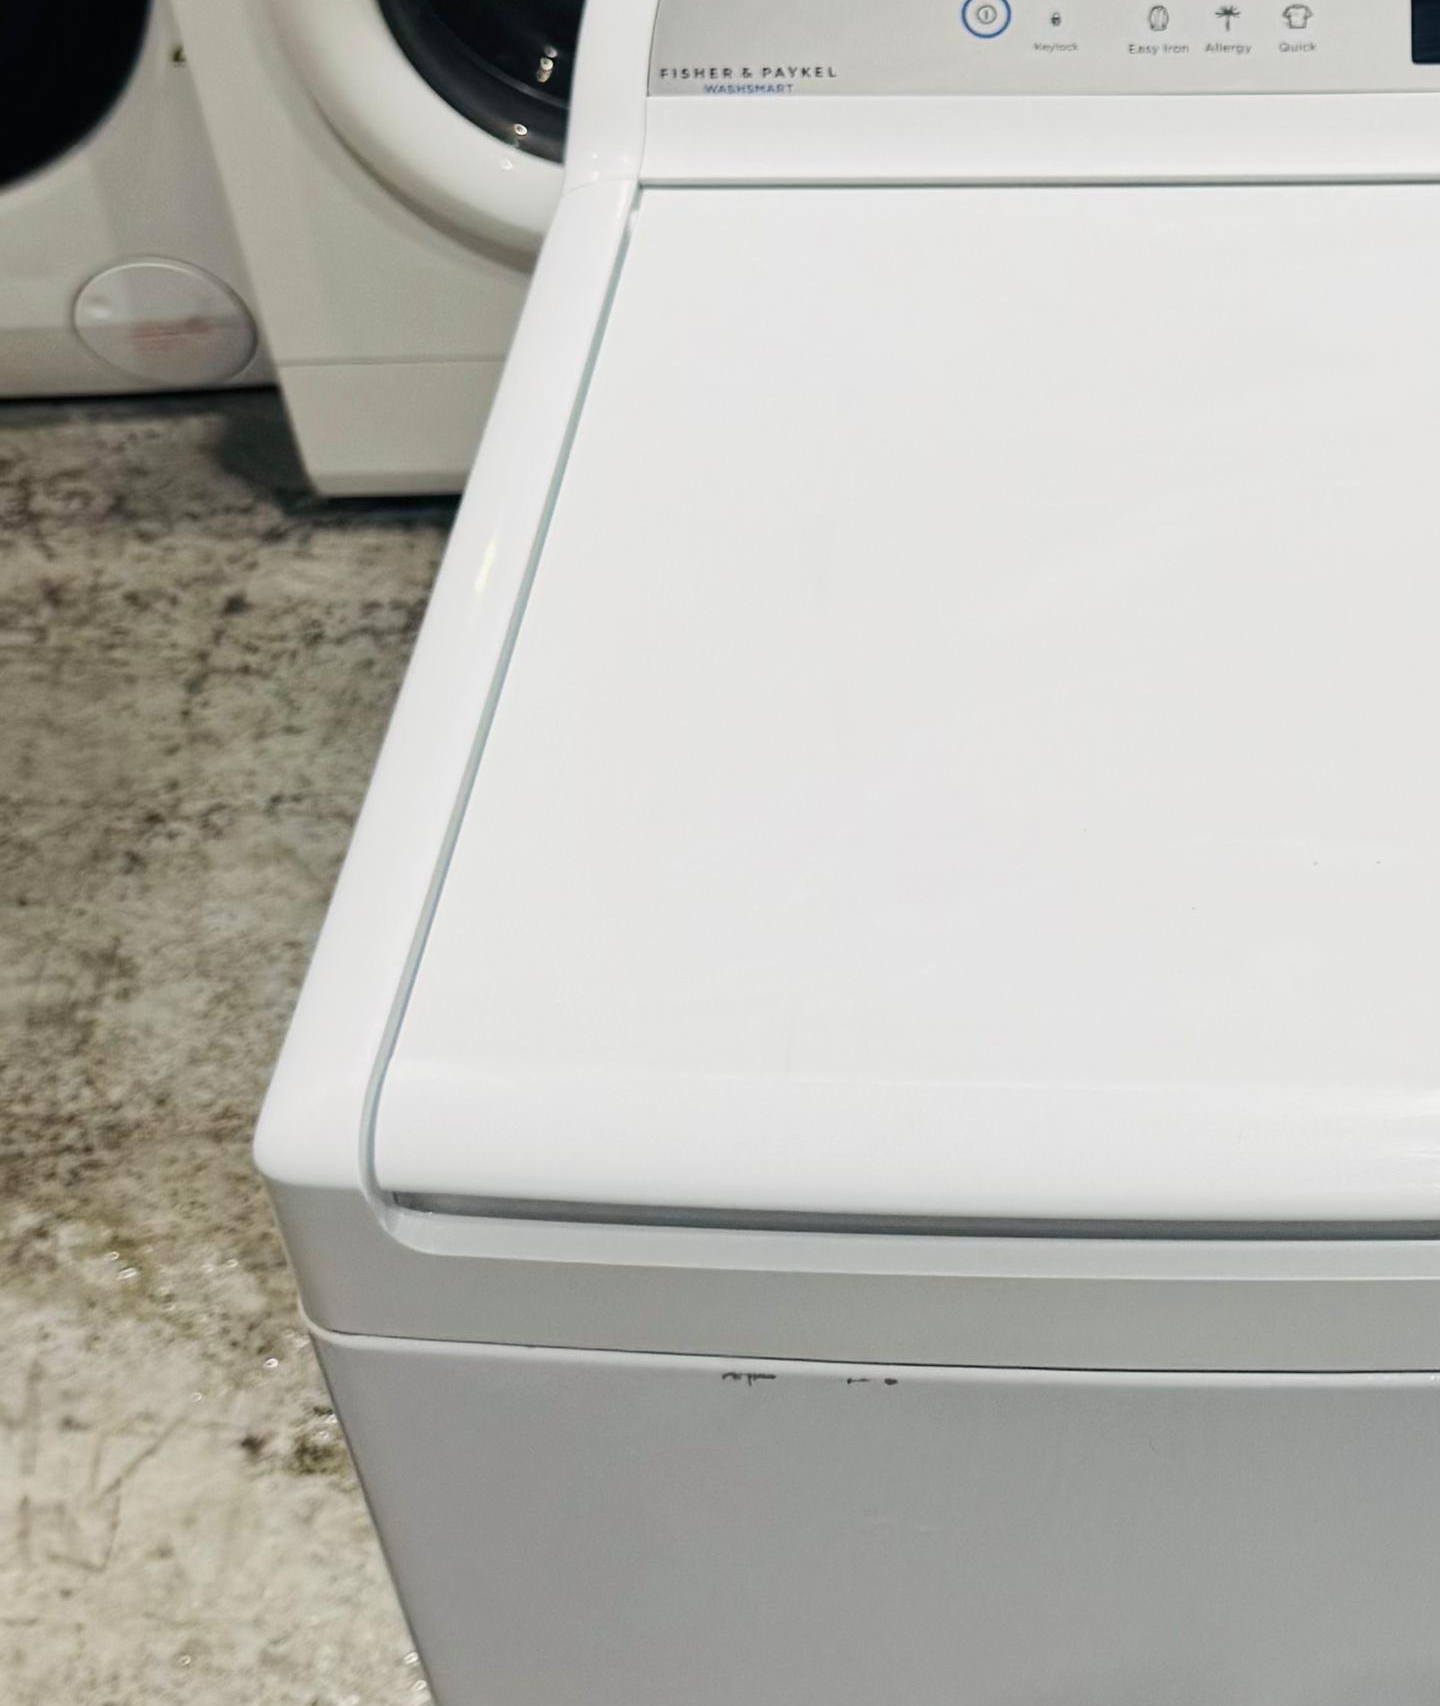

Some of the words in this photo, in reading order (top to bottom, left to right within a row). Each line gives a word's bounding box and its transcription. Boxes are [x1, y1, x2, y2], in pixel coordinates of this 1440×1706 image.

[1128, 44, 1159, 56] Easy
[1204, 43, 1252, 55] Allergy
[1278, 42, 1317, 53] Quick
[660, 67, 734, 80] FISHER
[742, 67, 752, 79] &
[762, 66, 838, 79] PAYKEL
[703, 82, 795, 94] WASHSMART
